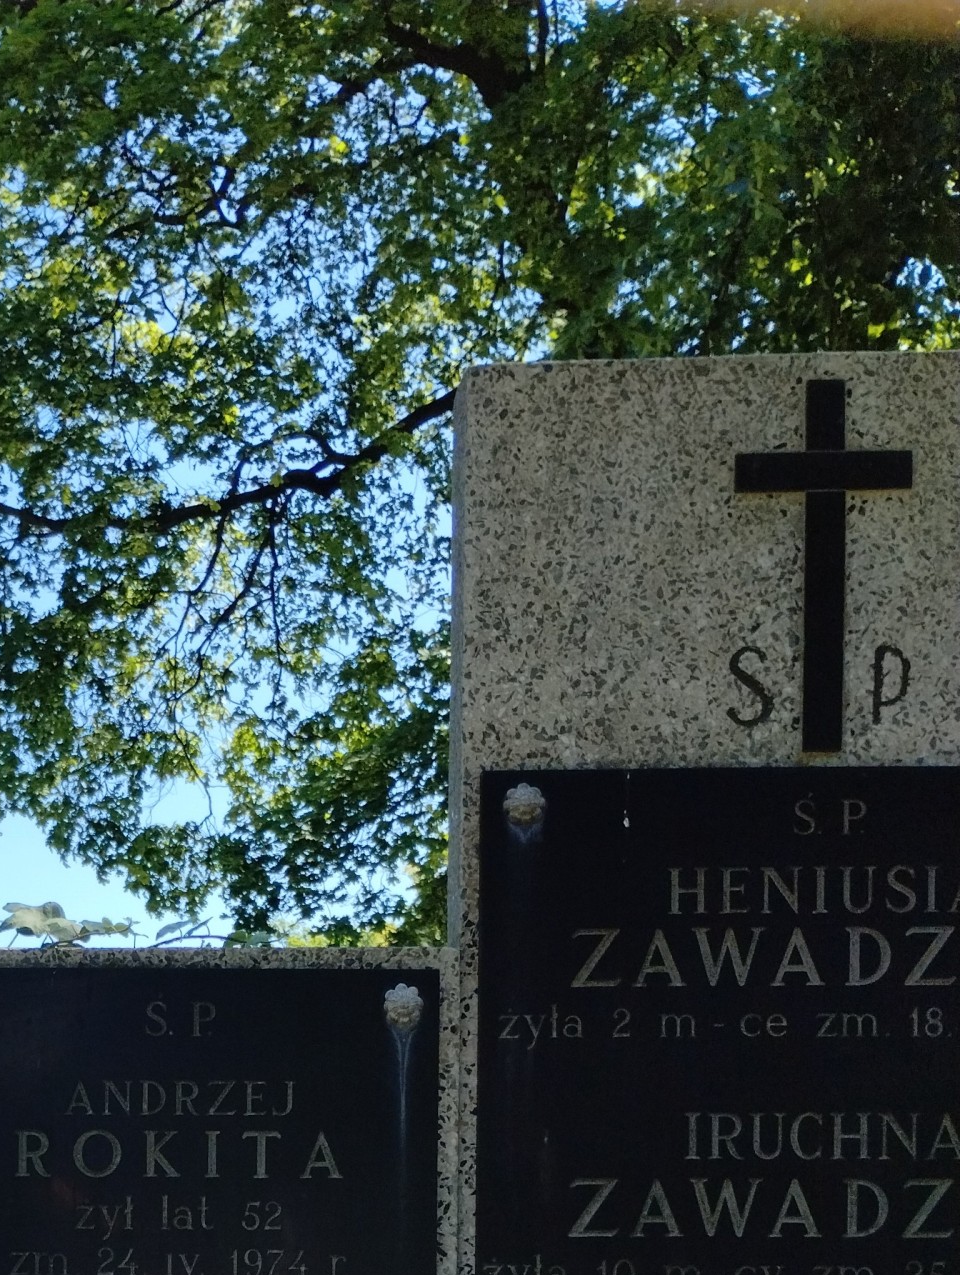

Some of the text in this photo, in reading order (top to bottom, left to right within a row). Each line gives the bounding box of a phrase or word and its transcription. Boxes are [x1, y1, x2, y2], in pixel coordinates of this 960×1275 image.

[498, 1004, 583, 1050] żyła
[612, 1010, 631, 1039] 2
[64, 1081, 296, 1116] ANDRZEJ
[14, 1129, 343, 1179] ROKITA
[75, 1195, 283, 1240] żył lat 52
